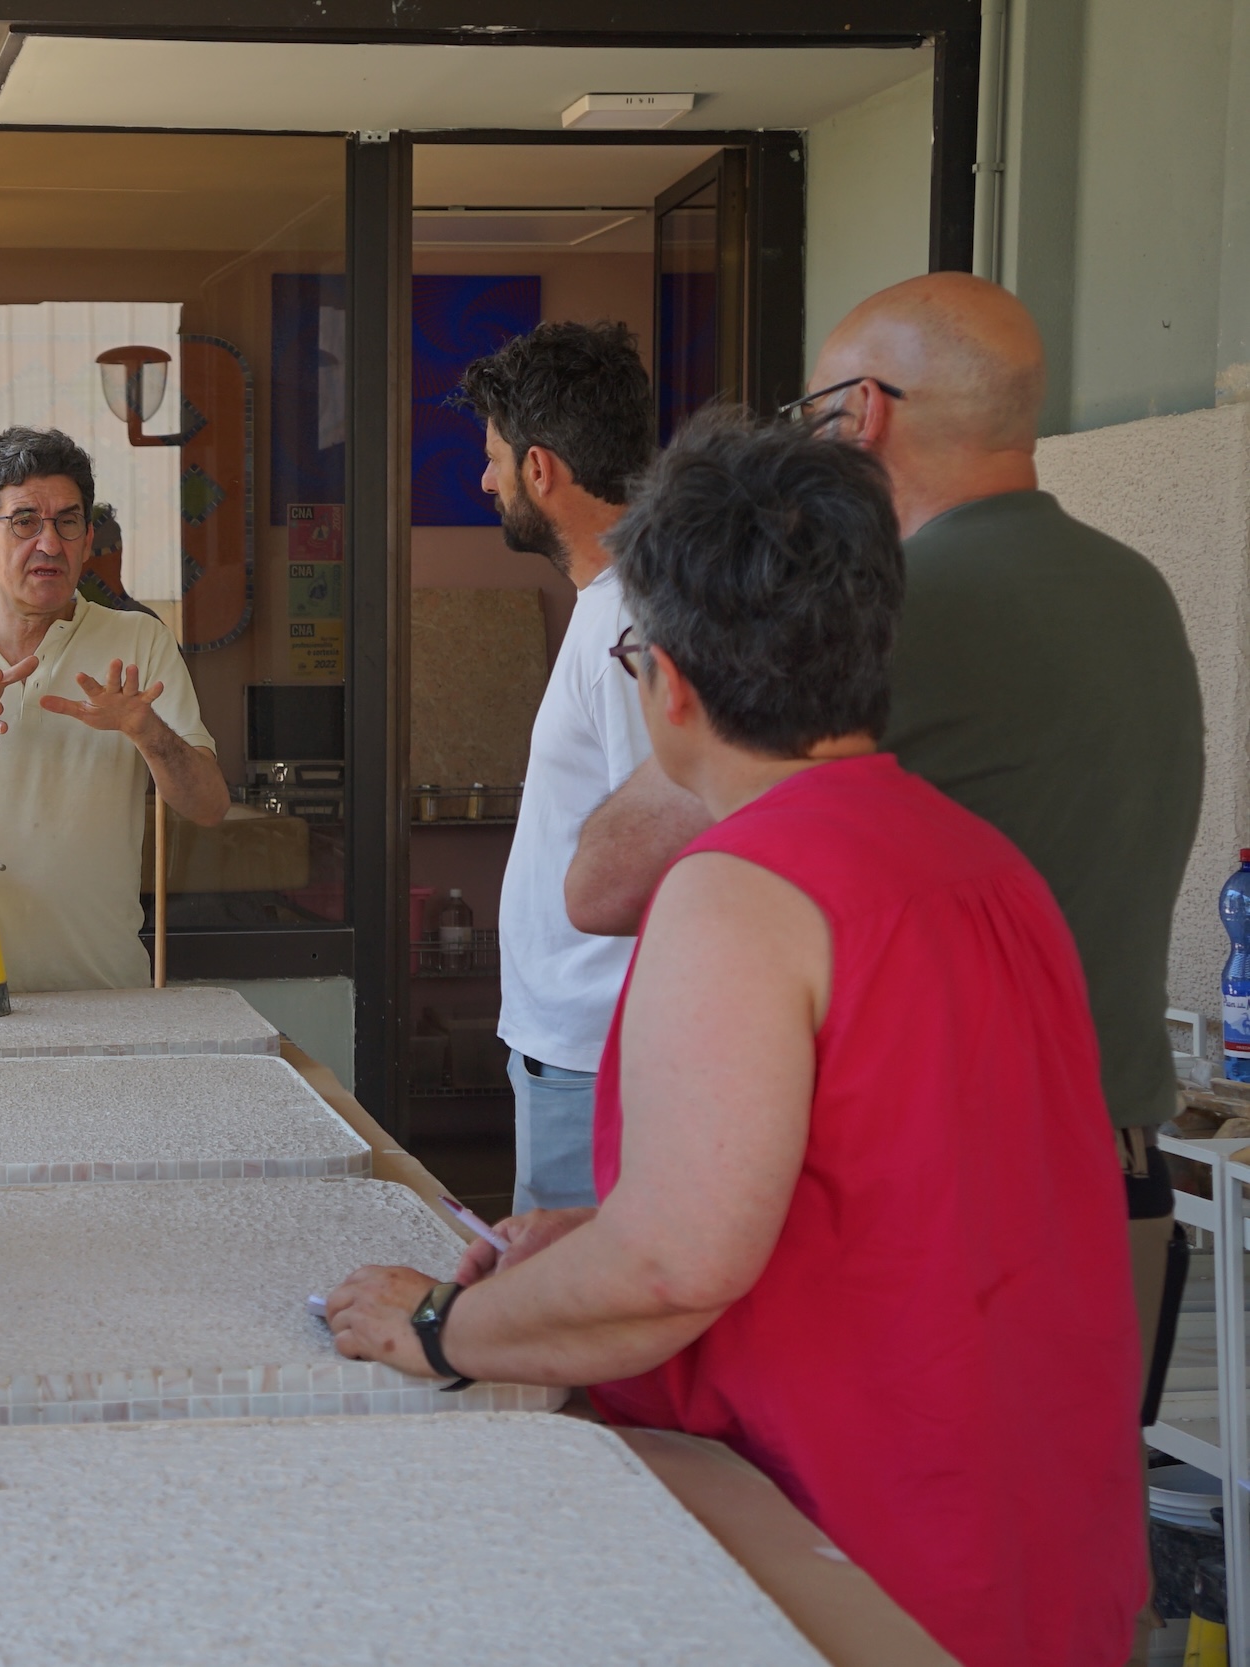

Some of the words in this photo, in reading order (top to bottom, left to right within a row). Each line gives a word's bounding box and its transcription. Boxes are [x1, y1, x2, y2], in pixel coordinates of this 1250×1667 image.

[291, 507, 313, 519] CNA
[332, 507, 341, 531] 2024
[291, 565, 313, 577] CNA
[291, 624, 313, 636] CNA
[314, 660, 337, 669] 2022
